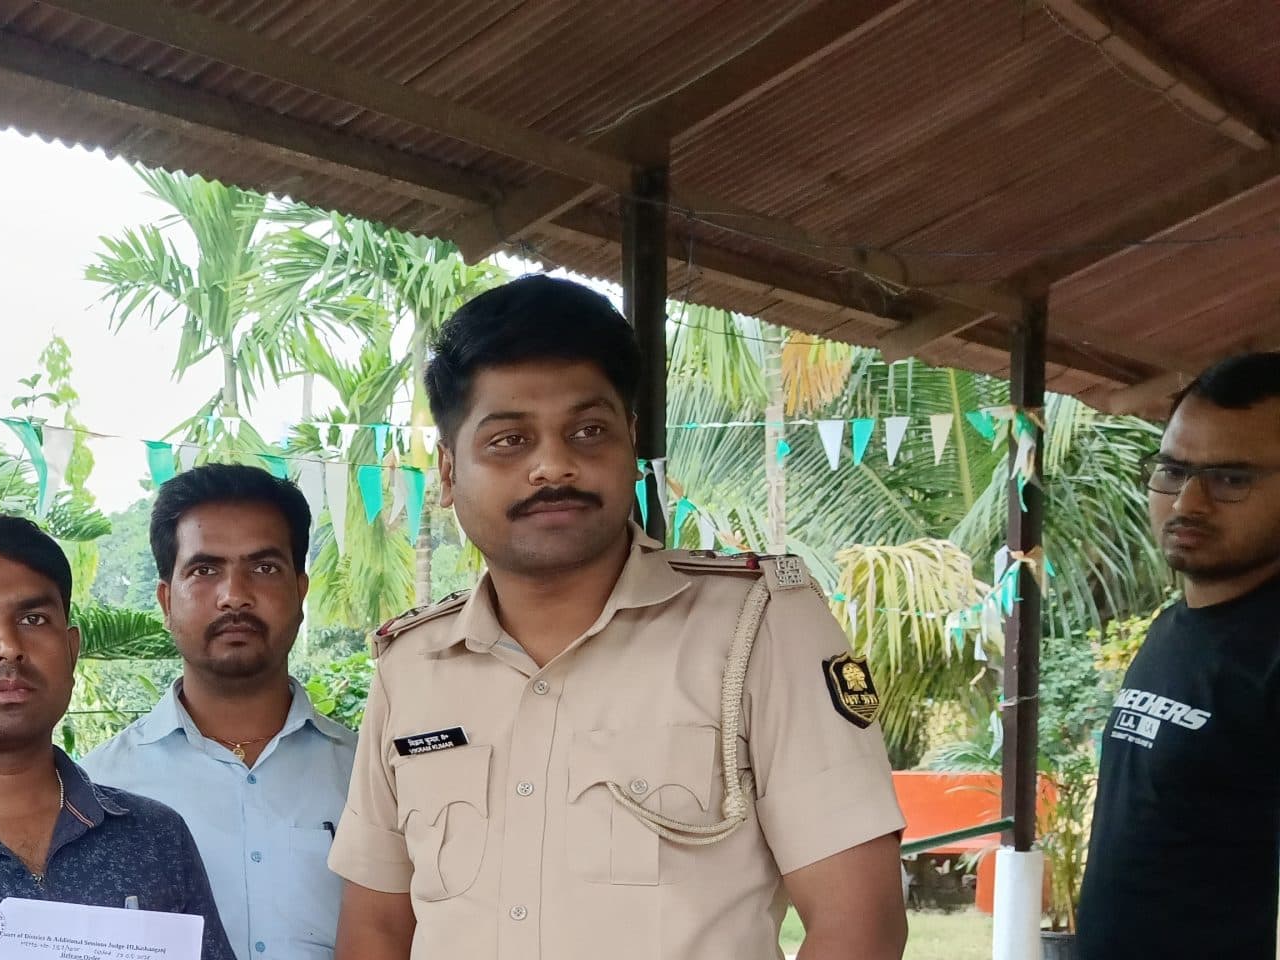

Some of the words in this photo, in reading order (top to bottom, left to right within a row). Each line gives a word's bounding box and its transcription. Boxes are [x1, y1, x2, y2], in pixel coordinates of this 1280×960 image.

[432, 741, 454, 750] KUMAR
[54, 936, 83, 945] Additional
[84, 940, 107, 948] Sessions
[108, 942, 125, 951] Judge
